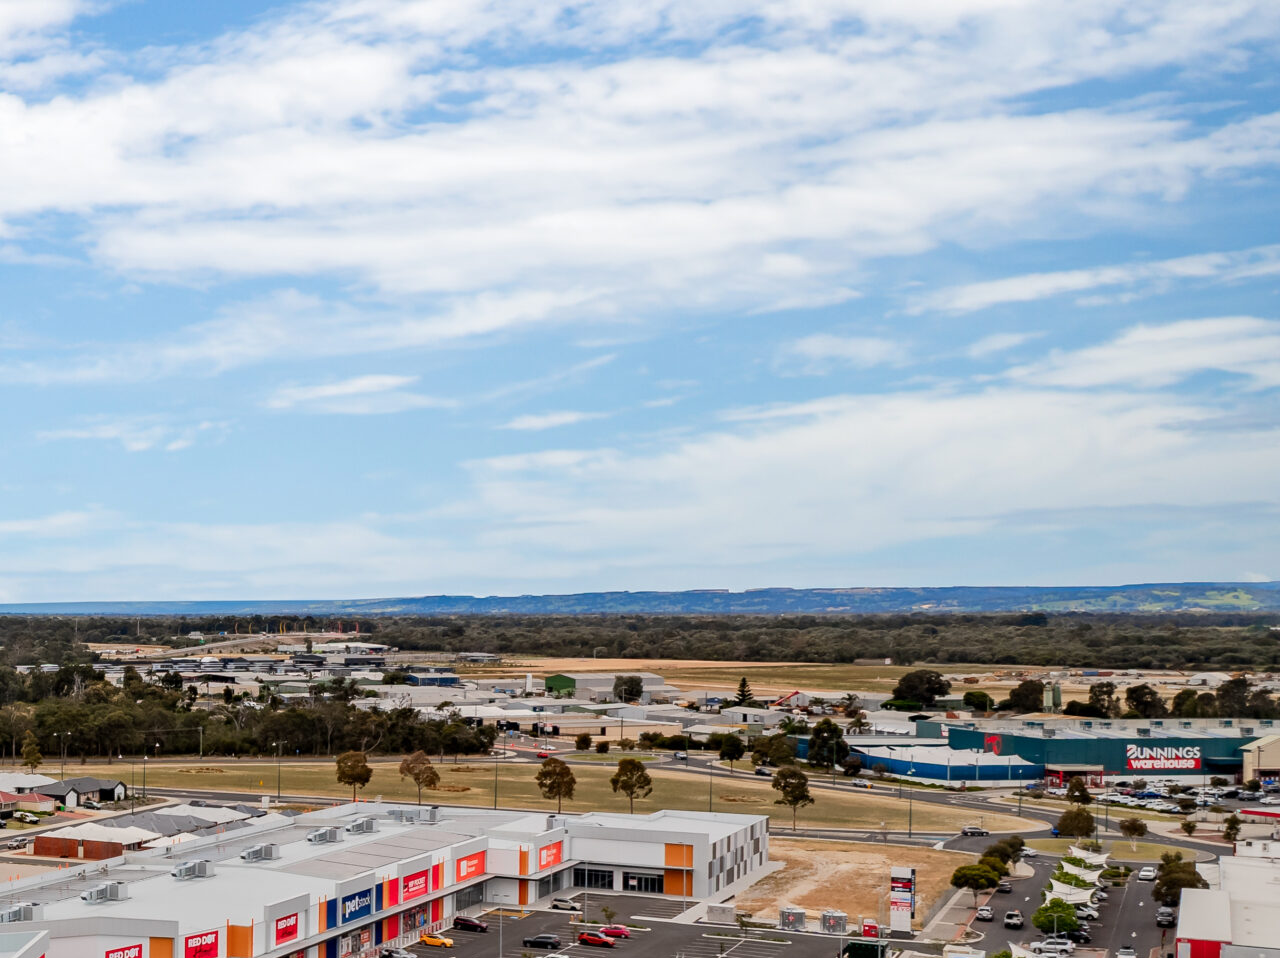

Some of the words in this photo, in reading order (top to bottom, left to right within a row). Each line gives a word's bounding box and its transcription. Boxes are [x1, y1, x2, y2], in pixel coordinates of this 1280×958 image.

[1126, 744, 1201, 759] BUNNINGS
[1130, 756, 1196, 769] warehouse
[344, 892, 371, 918] petstock
[187, 937, 202, 948] RED
[202, 934, 217, 946] DOT
